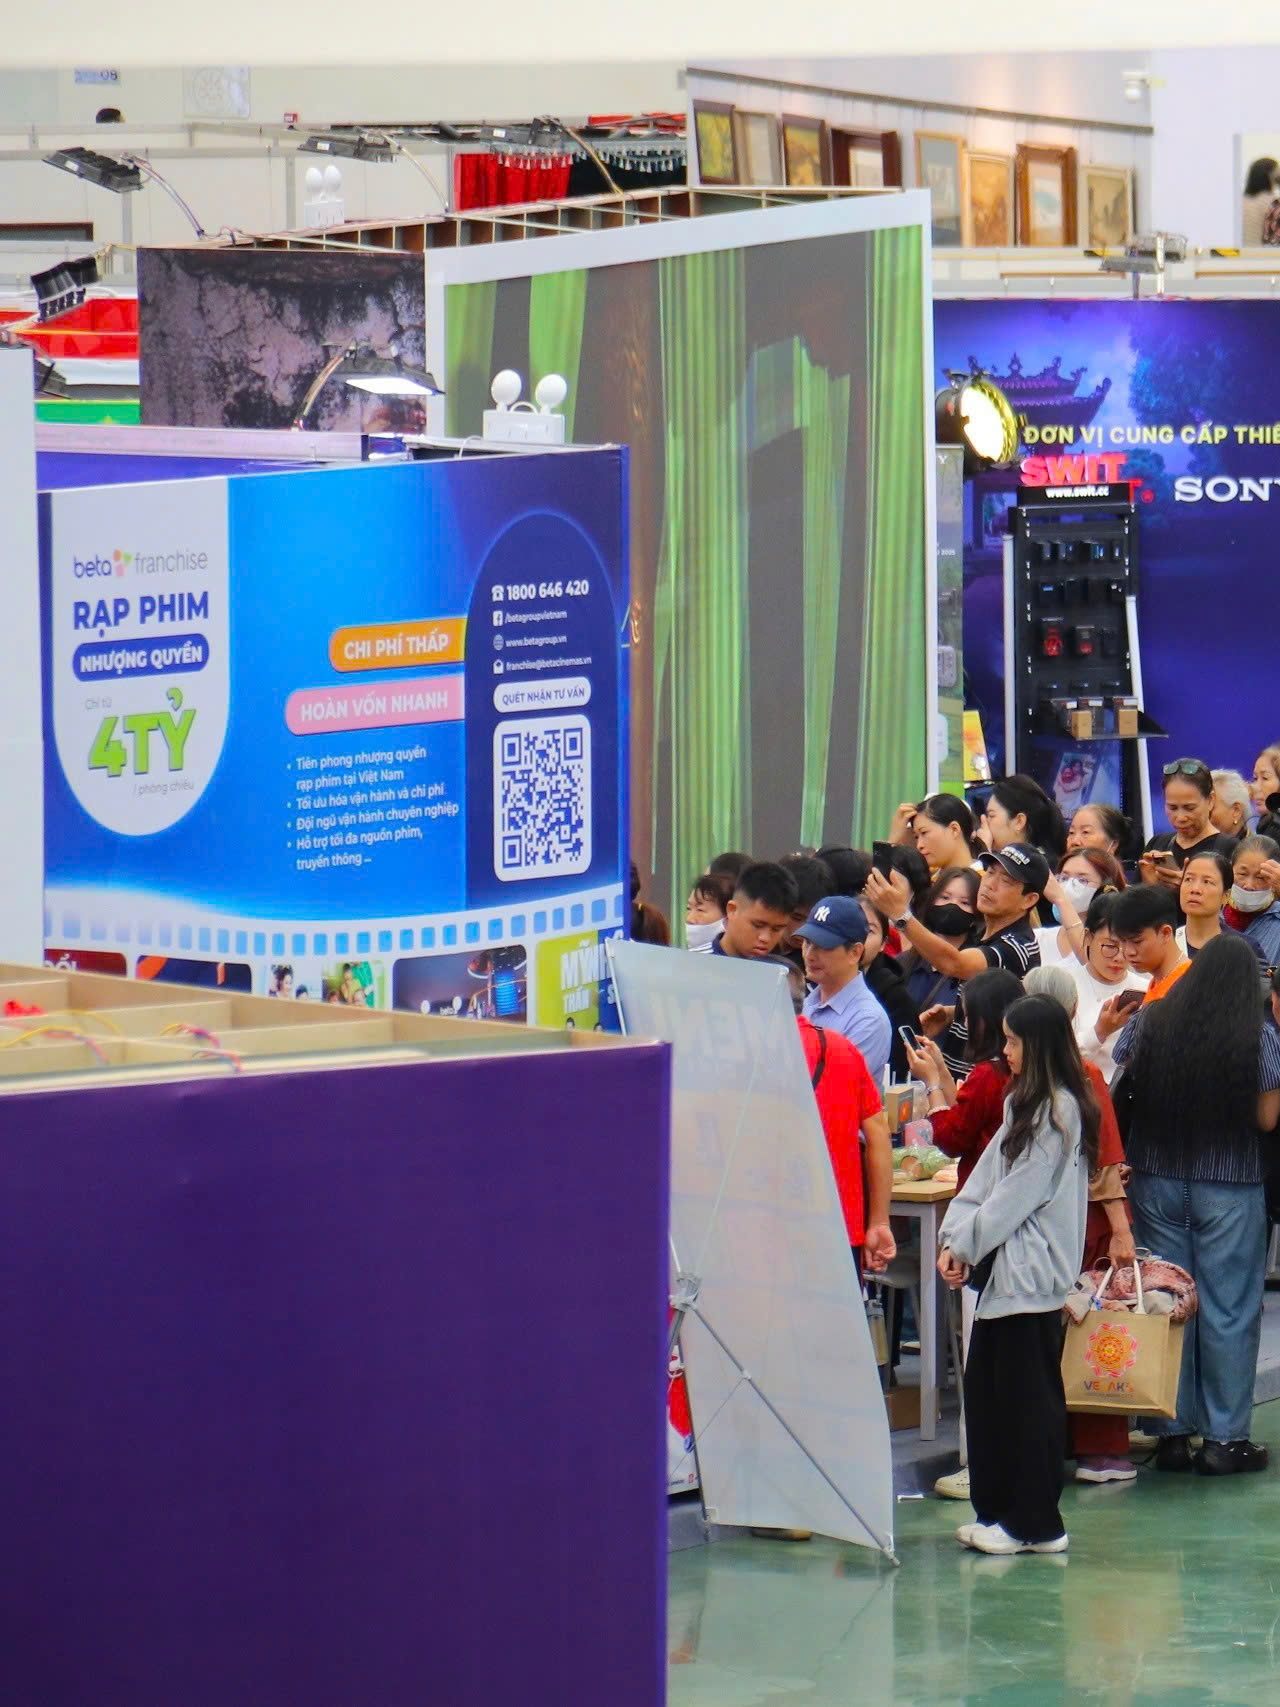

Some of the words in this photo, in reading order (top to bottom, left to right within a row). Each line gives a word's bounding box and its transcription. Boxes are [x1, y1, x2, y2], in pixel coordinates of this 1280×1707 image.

[1023, 424, 1074, 445] ĐƠN
[1081, 425, 1104, 448] VỊ
[1109, 425, 1174, 445] CUNG
[1180, 419, 1228, 445] CẤP
[1020, 453, 1127, 486] SWIT
[1045, 485, 1110, 499] www.swit.cc
[74, 555, 112, 578] beta
[134, 548, 208, 574] franchise
[506, 583, 536, 600] 1800
[538, 581, 563, 598] 646
[565, 579, 589, 596] 420
[73, 598, 130, 638] RẠP
[140, 591, 208, 624] PHIM
[344, 640, 371, 660] CHI
[376, 633, 402, 657] PHÍ
[407, 627, 449, 654] THẤP
[80, 650, 147, 675] NHƯỢNG
[151, 641, 203, 669] QUYỀN
[301, 698, 347, 722] HOÀN
[352, 690, 387, 716] VỐN
[391, 691, 448, 712] NHANH
[502, 692, 525, 706] QUÉT
[527, 690, 552, 704] NHẬN
[567, 684, 585, 699] VẤN
[296, 757, 317, 770] Tiên
[320, 754, 353, 771] phong
[296, 780, 312, 793] rạp
[315, 775, 341, 791] phim
[344, 772, 356, 788] tại
[358, 769, 379, 786] Việt
[381, 769, 404, 781] Nam
[370, 788, 395, 802] hành
[411, 784, 426, 798] chi
[296, 817, 313, 831] Đội
[358, 810, 384, 823] hành
[332, 852, 363, 867] thông
